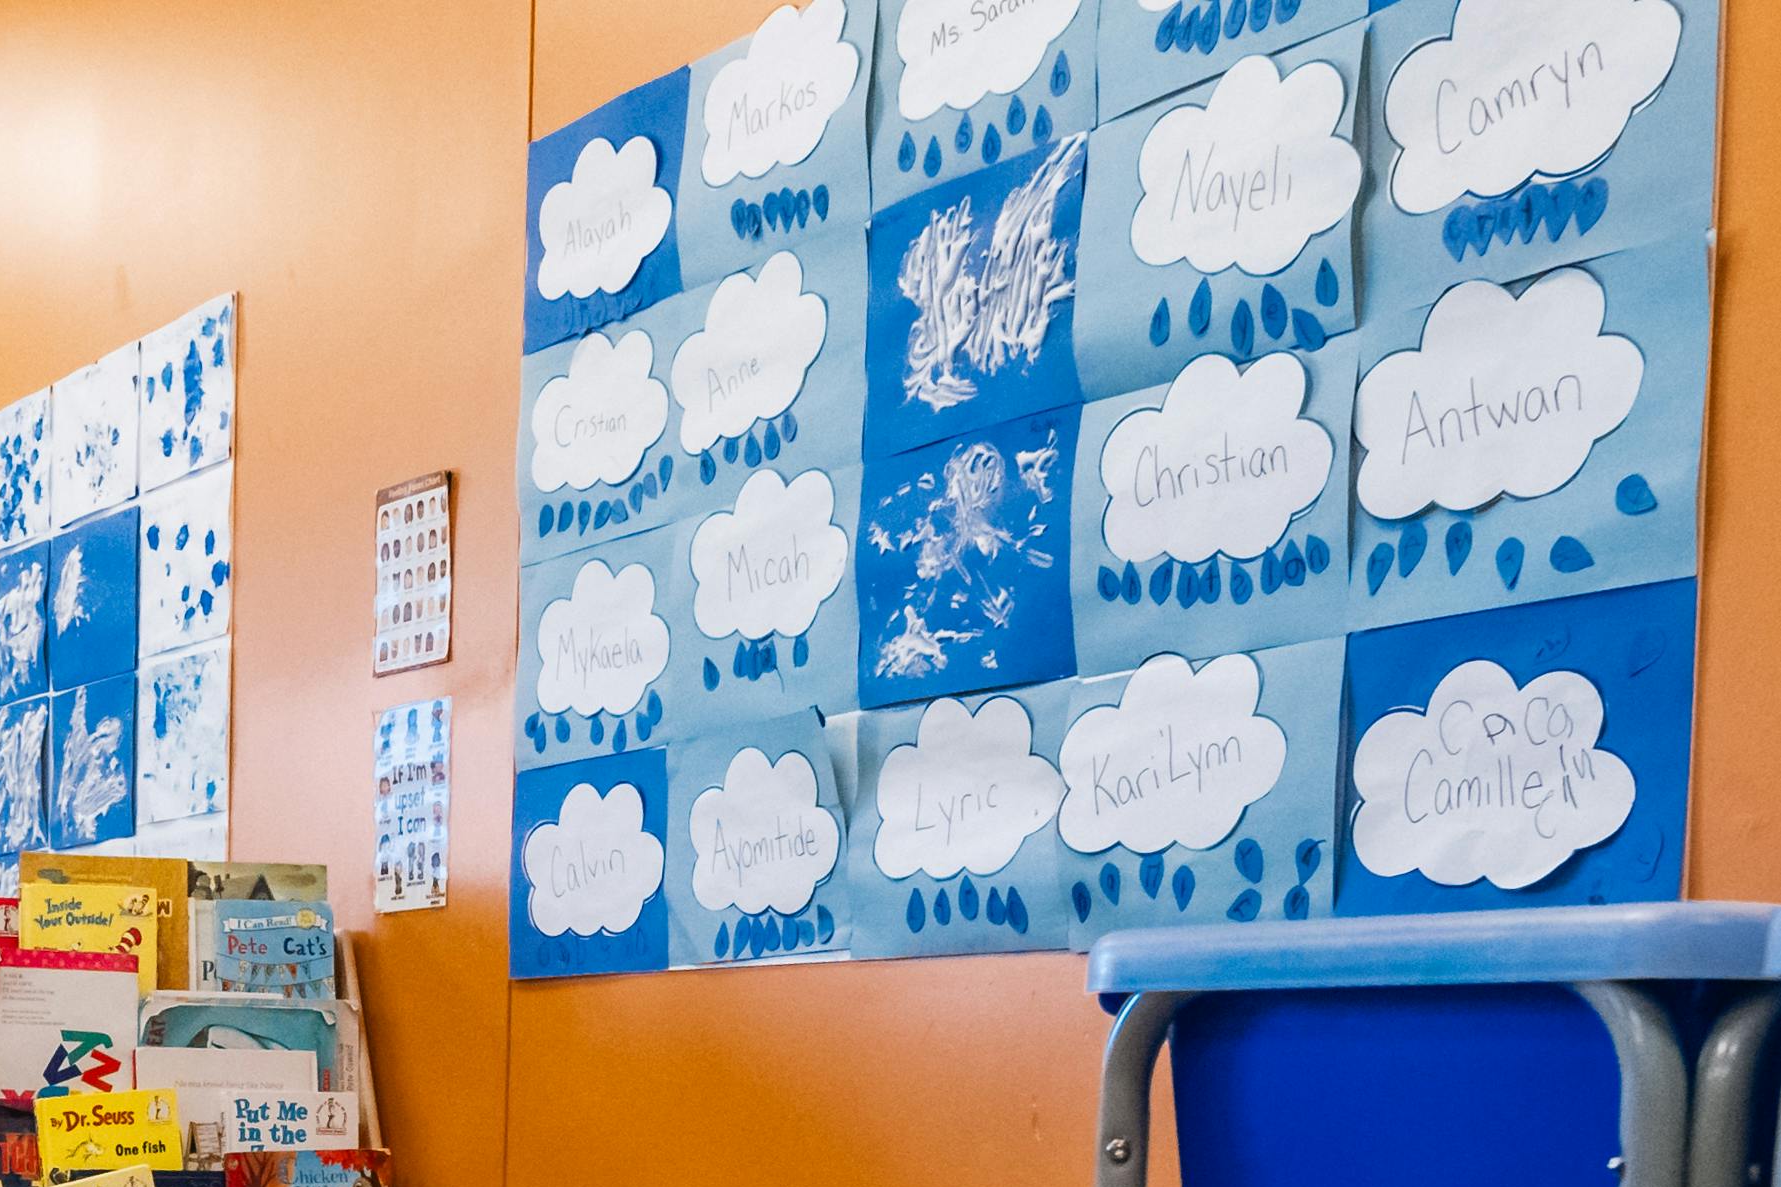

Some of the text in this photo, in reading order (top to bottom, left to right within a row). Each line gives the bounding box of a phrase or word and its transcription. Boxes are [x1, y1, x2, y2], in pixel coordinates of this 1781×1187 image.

[929, 22, 965, 56] Ms.
[1434, 40, 1605, 156] Camryn
[1169, 144, 1294, 232] Nayeli
[706, 353, 762, 413] Anne
[553, 405, 628, 449] Cristian
[1401, 372, 1584, 466] Antwan
[1133, 434, 1290, 509] Christian
[726, 534, 811, 603] Micah
[1405, 749, 1545, 824] Camille
[914, 781, 1000, 849] Lyric
[550, 845, 626, 898] Calvin
[711, 822, 820, 886] Ayomitide
[34, 912, 115, 931] Your Outside!
[44, 897, 83, 914] Inside
[227, 934, 328, 956] Pete Cat's
[50, 1104, 135, 1132] By Dr. Seuss
[234, 1098, 271, 1124] Put
[277, 1100, 309, 1122] Me
[238, 1124, 308, 1146] in the
[115, 1140, 167, 1157] One fish
[278, 1157, 349, 1185] Chicken
